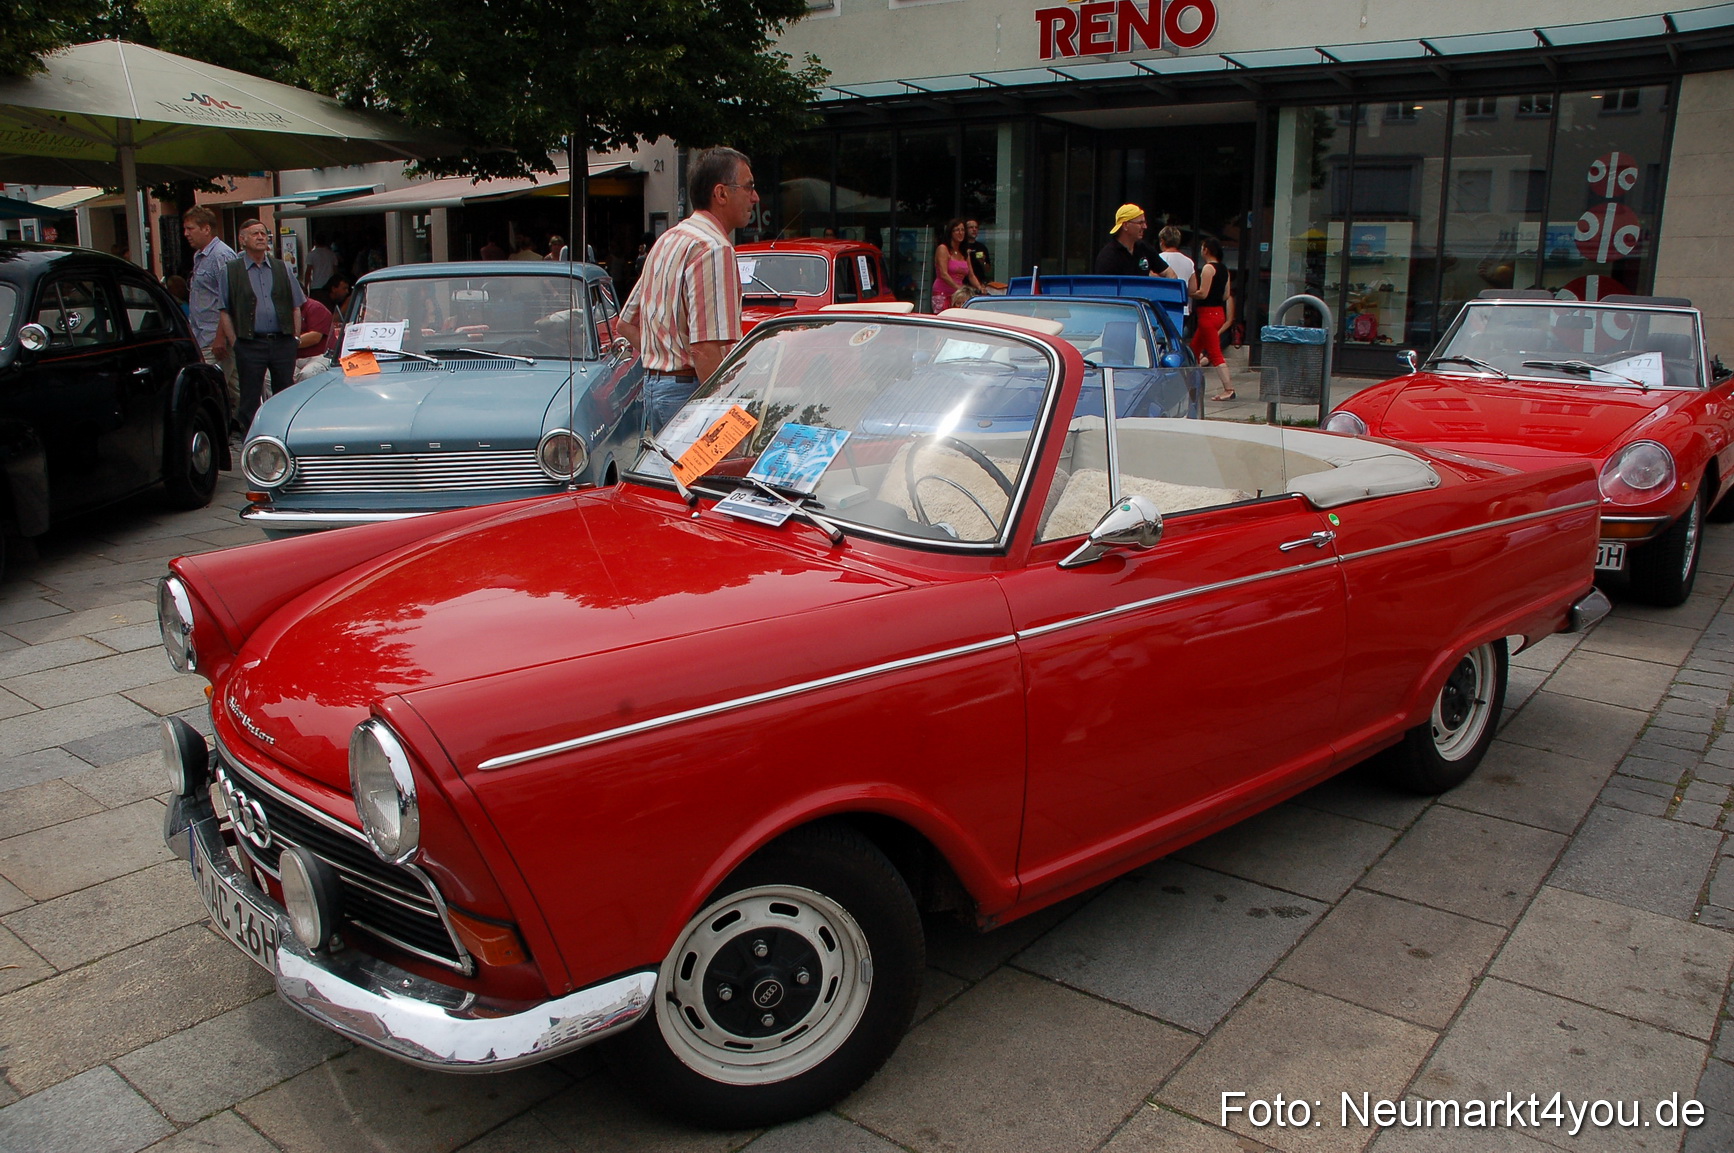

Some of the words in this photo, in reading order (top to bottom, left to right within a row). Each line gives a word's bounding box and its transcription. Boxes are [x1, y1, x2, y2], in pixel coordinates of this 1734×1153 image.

[1034, 0, 1218, 60] RENO
[653, 158, 664, 172] 21
[370, 326, 397, 339] 529
[233, 900, 277, 964] 16H
